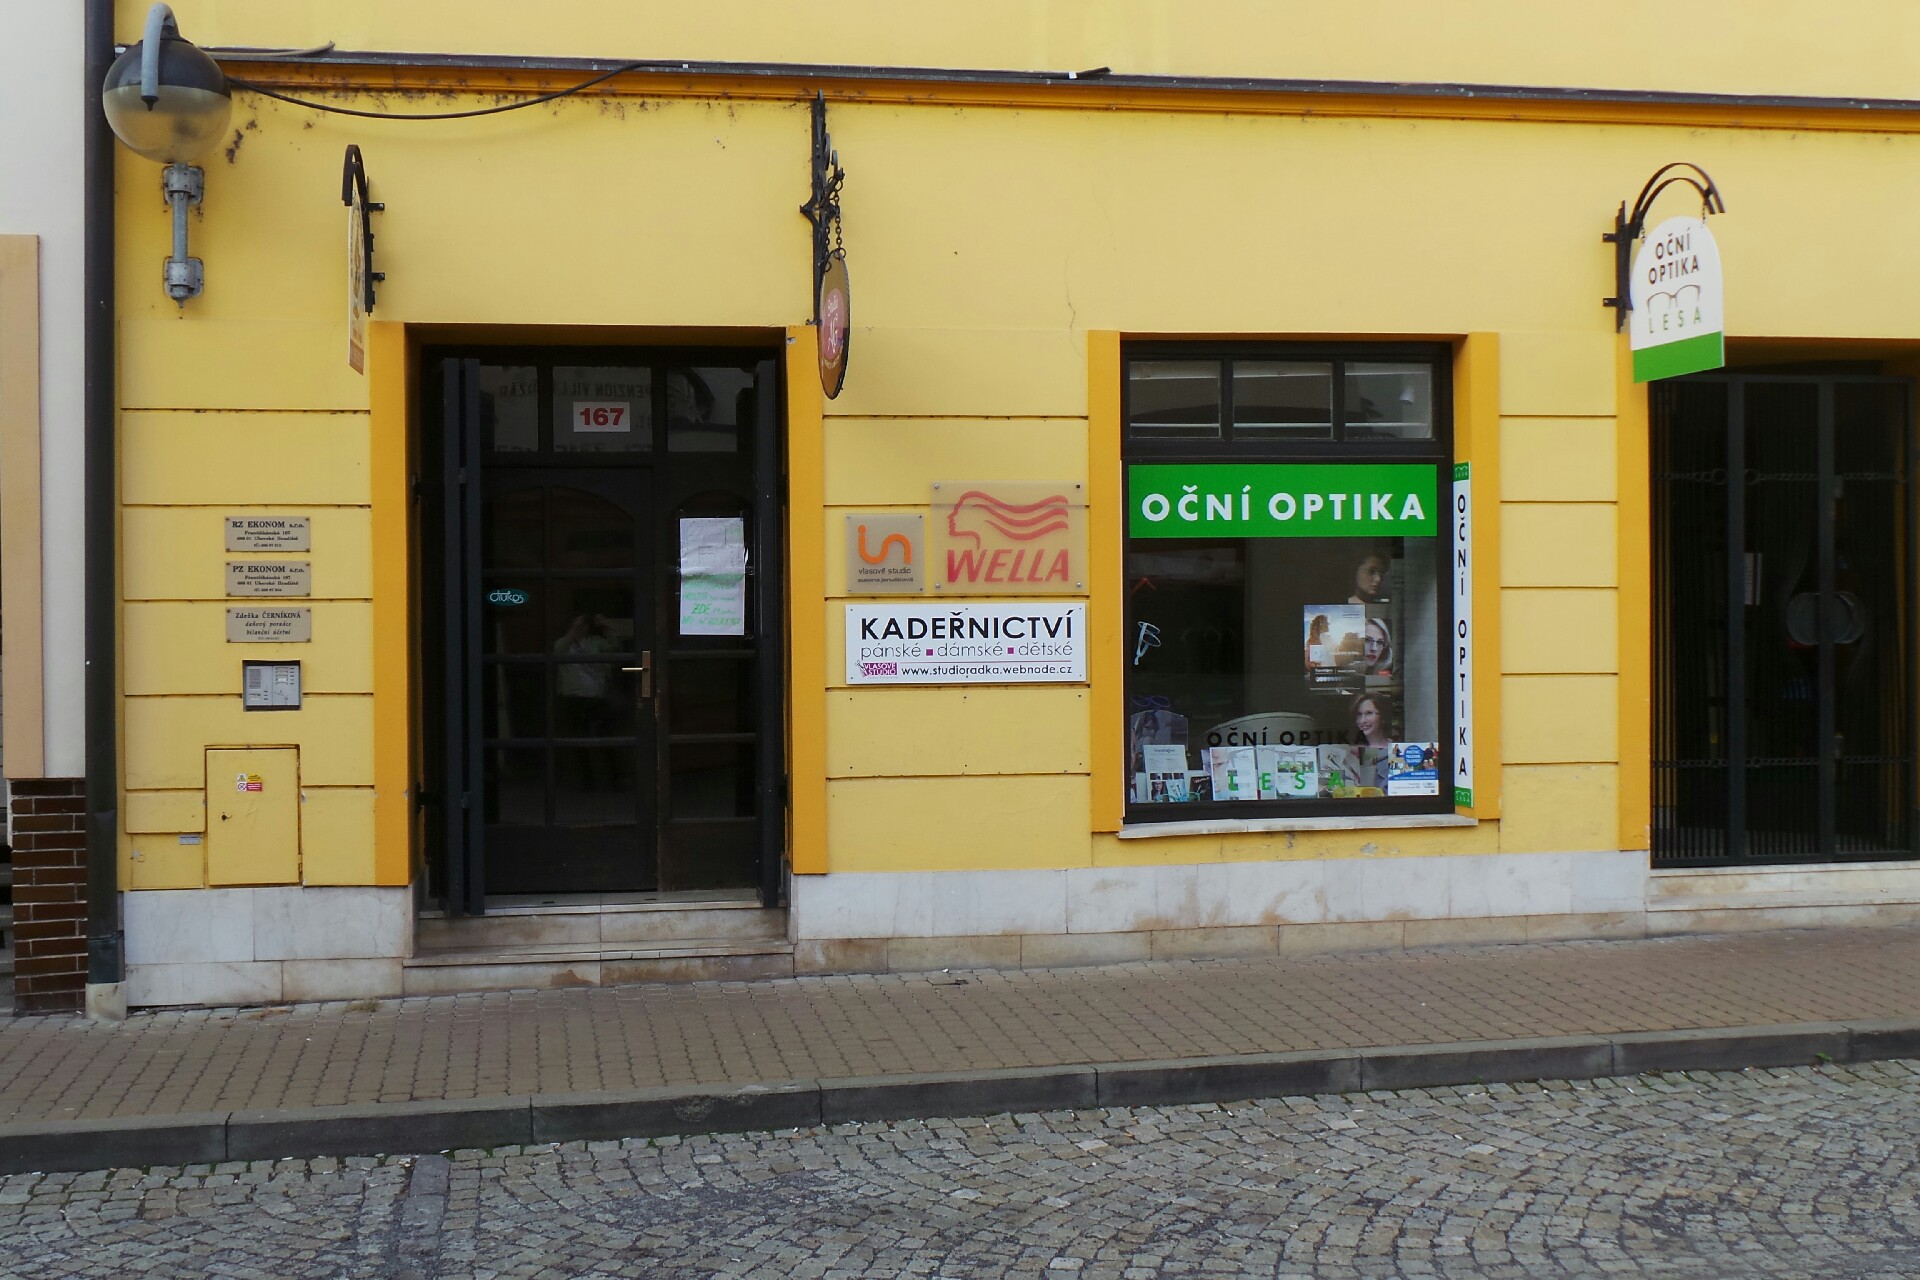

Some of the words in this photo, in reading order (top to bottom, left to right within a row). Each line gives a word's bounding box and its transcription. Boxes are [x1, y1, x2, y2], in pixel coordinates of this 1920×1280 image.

[1655, 227, 1690, 260] OČNÍ
[1648, 255, 1699, 285] OPTIKA
[1649, 306, 1702, 334] LESA
[580, 407, 624, 426] 167
[1141, 484, 1251, 522] OČNÍ
[1268, 492, 1425, 521] OPTIKA
[1457, 494, 1466, 596] OČNÍ
[887, 567, 912, 575] studio
[947, 549, 1069, 583] WELLA
[245, 620, 267, 628] daňový
[262, 611, 301, 619] ČERNÍKOVÁ
[861, 609, 1074, 640] KADEŘNICTVÍ
[860, 642, 921, 661] pánské
[937, 642, 1003, 658] dámské
[1018, 641, 1073, 656] dětské
[901, 665, 1073, 676] www.studioradka.webnode.cz
[1458, 619, 1467, 776] OPTIKA
[1207, 726, 1268, 747] OČNÍ
